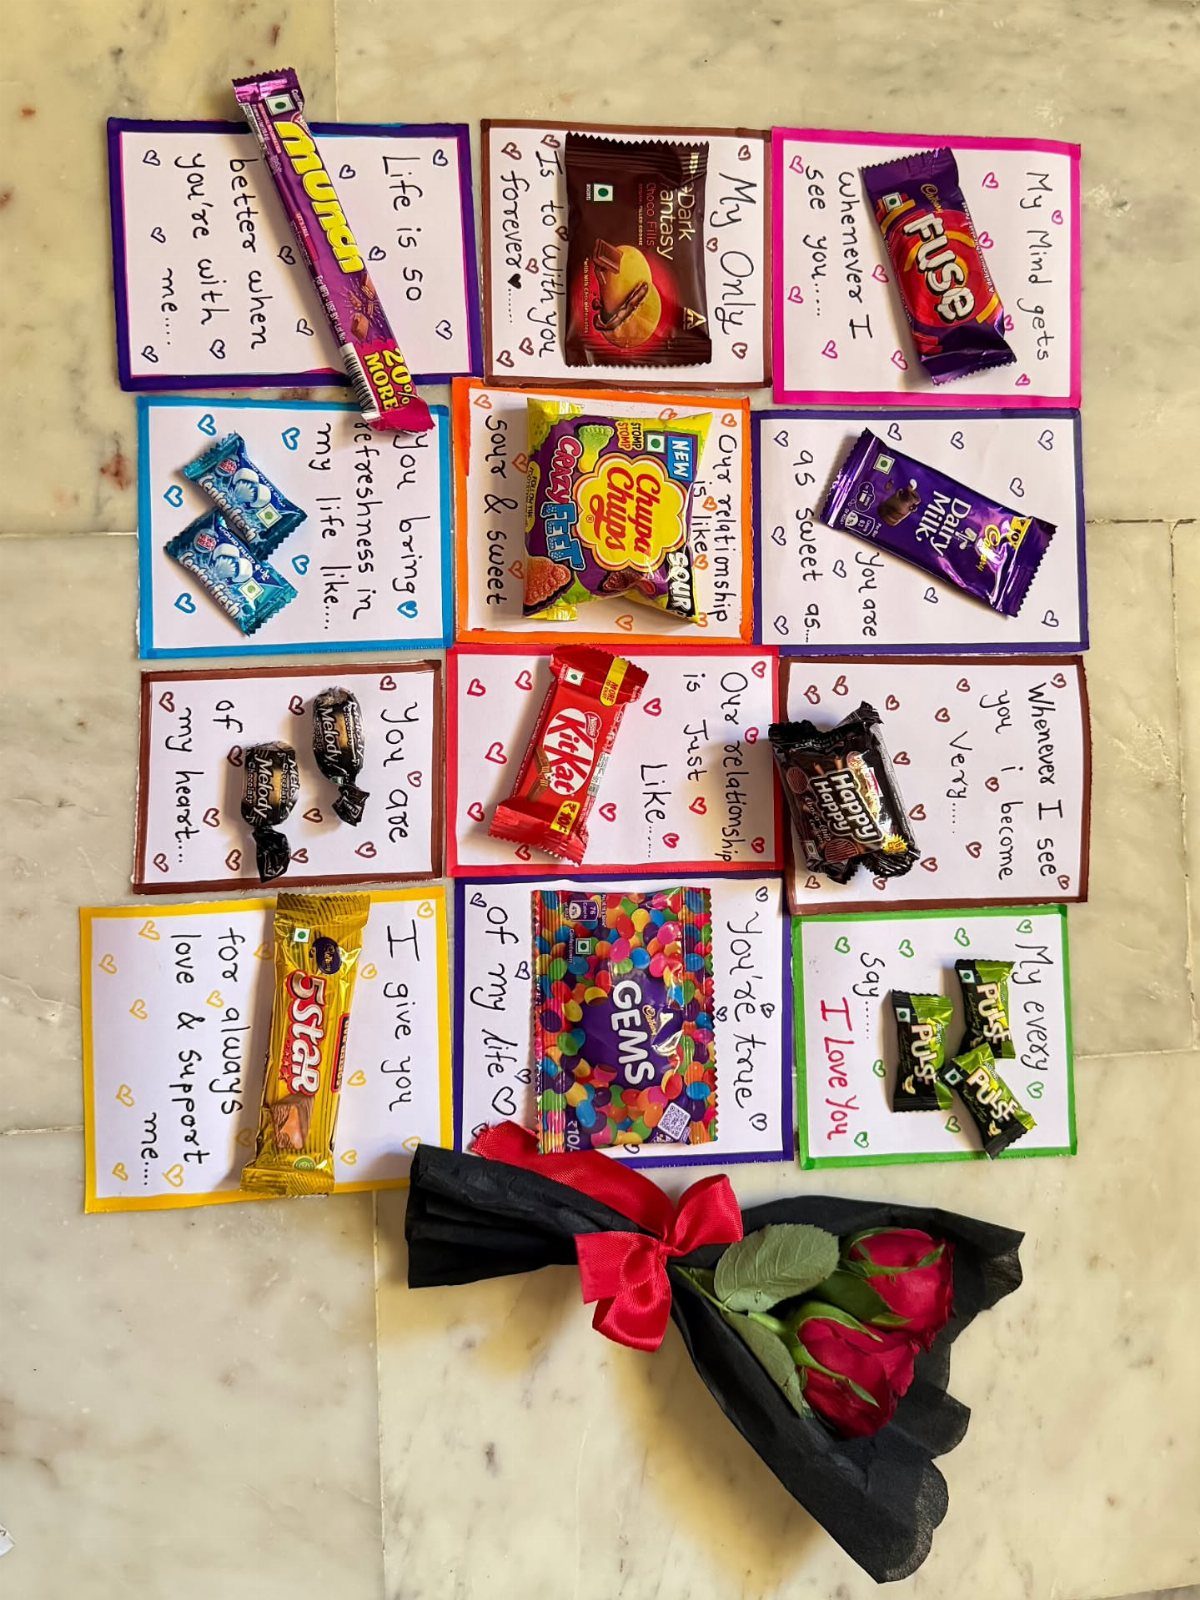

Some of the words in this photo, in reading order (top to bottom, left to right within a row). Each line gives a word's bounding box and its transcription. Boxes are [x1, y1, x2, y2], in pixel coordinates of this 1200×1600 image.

[382, 156, 422, 212] Life
[536, 151, 563, 178] Is
[804, 165, 828, 211] see
[1019, 172, 1053, 210] My
[541, 200, 564, 227] to
[646, 182, 657, 217] Choco
[656, 184, 676, 261] antasy
[677, 192, 696, 242] Dark
[710, 173, 757, 227] My
[228, 158, 258, 253] better
[247, 269, 271, 350] when
[397, 227, 422, 248] is
[646, 221, 657, 246] Fills
[1027, 230, 1053, 284] Mind
[196, 258, 231, 326] with
[715, 250, 756, 335] Only
[527, 309, 556, 358] you
[848, 314, 873, 340] I
[1017, 297, 1055, 361] gets
[362, 352, 399, 409] MORE
[381, 347, 414, 406] 20%
[308, 423, 332, 472] my
[484, 415, 510, 479] sour
[616, 422, 630, 450] STOMP
[631, 423, 642, 449] STOMP
[672, 440, 690, 478] NEW
[712, 434, 737, 483] Our
[545, 436, 582, 503] CRAZY
[692, 481, 711, 498] is
[793, 450, 815, 487] as
[316, 497, 344, 540] life
[484, 494, 518, 514] &
[591, 467, 635, 551] Chups
[627, 473, 661, 555] Chupa
[915, 491, 951, 542] Milk
[930, 498, 972, 557] Dairy
[392, 515, 431, 594] bring
[540, 501, 585, 571] FEET
[692, 515, 712, 555] like
[707, 494, 737, 623] relationship
[795, 507, 822, 582] sweet
[485, 530, 508, 606] sweet
[668, 552, 692, 608] SOUR
[352, 588, 376, 620] in
[862, 599, 880, 637] are
[682, 673, 706, 693] is
[720, 671, 748, 725] Our
[165, 707, 192, 753] my
[213, 700, 243, 733] of
[320, 708, 342, 762] Melody
[1028, 682, 1055, 785] Whenever
[542, 714, 594, 793] KitKat
[683, 720, 709, 782] Just
[253, 754, 274, 819] Melody
[714, 740, 745, 863] relationship
[813, 780, 851, 831] Happy
[830, 774, 878, 839] Happy
[979, 690, 1011, 734] you
[998, 801, 1023, 881] become
[1038, 799, 1063, 821] I
[385, 789, 410, 844] are
[1037, 838, 1058, 877] see
[387, 919, 420, 962] I
[486, 906, 519, 945] of
[171, 934, 202, 985] love
[218, 927, 245, 983] for
[1012, 943, 1054, 984] My
[383, 982, 416, 1040] give
[470, 964, 508, 1011] my
[820, 997, 852, 1032] I
[976, 982, 1011, 1044] PULSE
[177, 1011, 205, 1031] &
[611, 980, 655, 1085] GEMS
[1020, 1001, 1051, 1071] every
[209, 1007, 251, 1116] always
[481, 1028, 518, 1079] life
[733, 1034, 766, 1109] true
[824, 1036, 855, 1089] Love
[910, 1024, 938, 1085] PULSE
[380, 1056, 411, 1112] you
[966, 1067, 1019, 1121] PULSE
[825, 1095, 860, 1140] You
